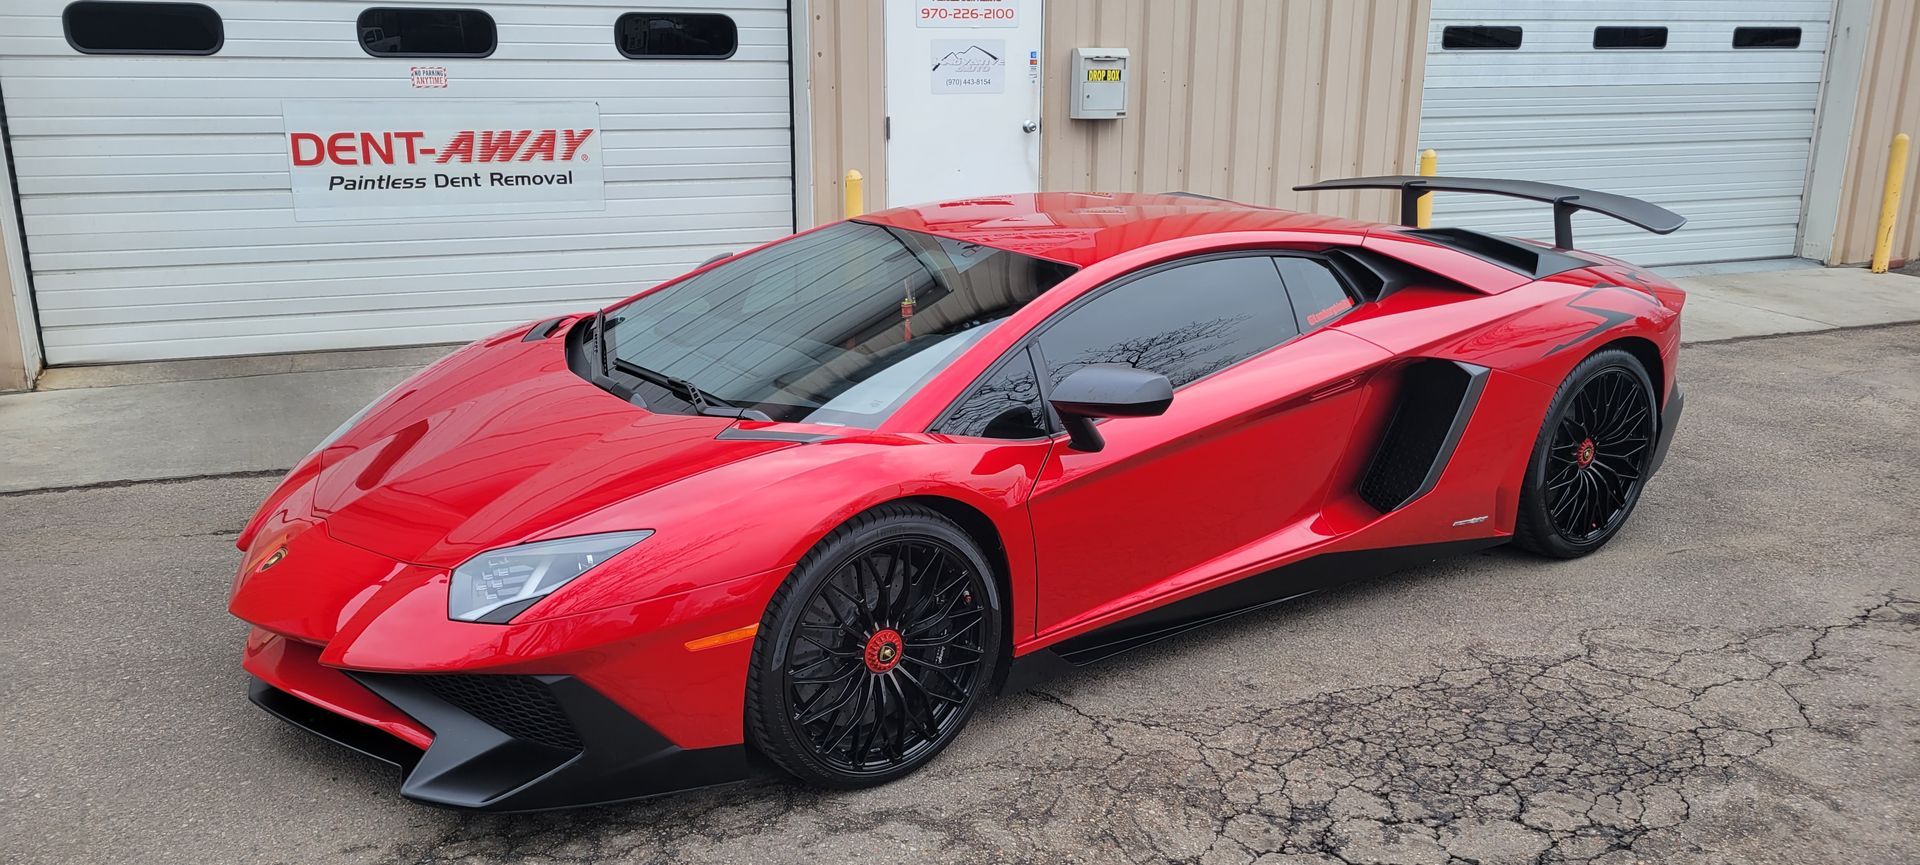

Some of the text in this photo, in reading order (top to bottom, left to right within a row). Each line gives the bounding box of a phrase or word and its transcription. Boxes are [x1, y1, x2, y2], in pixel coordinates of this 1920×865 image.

[921, 8, 1014, 19] 970-226-2100
[1089, 70, 1120, 81] DROP BOX
[945, 78, 962, 86] (970)
[290, 129, 594, 166] DENT-AWAY
[329, 170, 573, 190] Paintless Dent Removal
